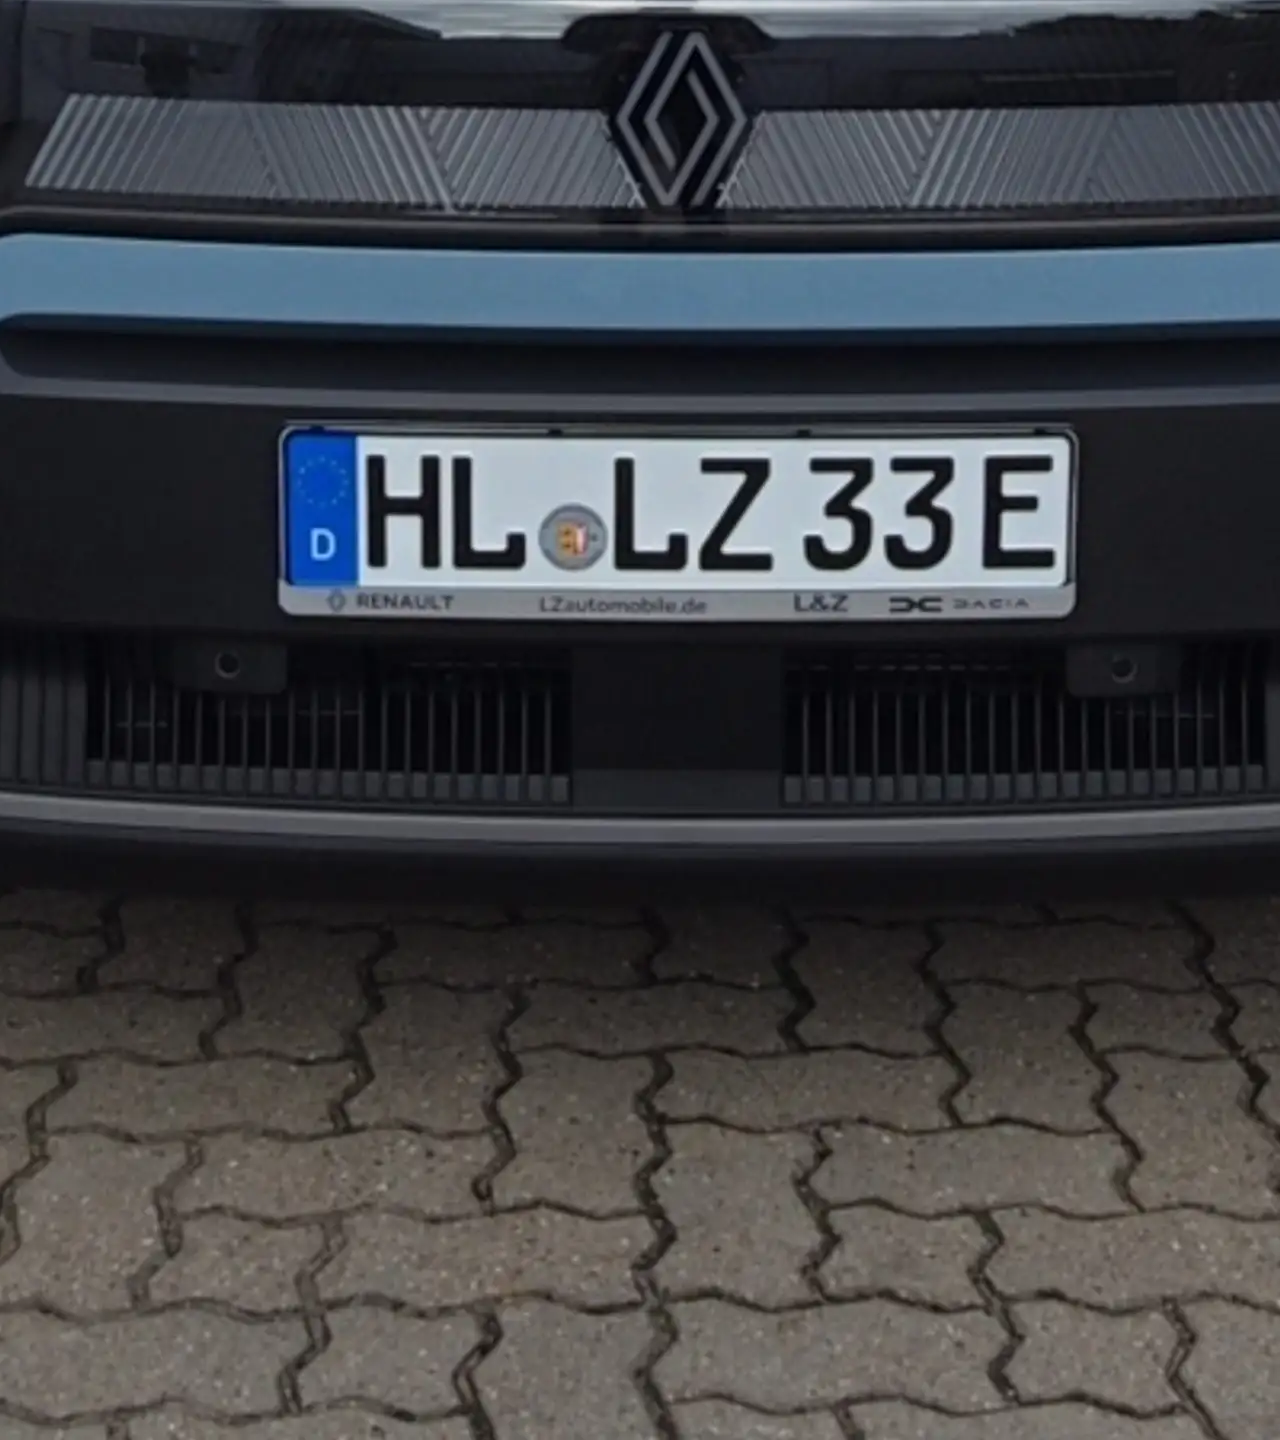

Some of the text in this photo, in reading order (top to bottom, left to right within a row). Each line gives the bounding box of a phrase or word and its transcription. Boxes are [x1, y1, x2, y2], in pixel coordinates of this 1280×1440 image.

[366, 455, 526, 568] HL
[614, 457, 773, 570] LZ
[311, 529, 337, 560] D
[356, 593, 455, 610] RENAULT
[540, 596, 707, 615] LZautomobile.de
[792, 594, 849, 612] L&Z
